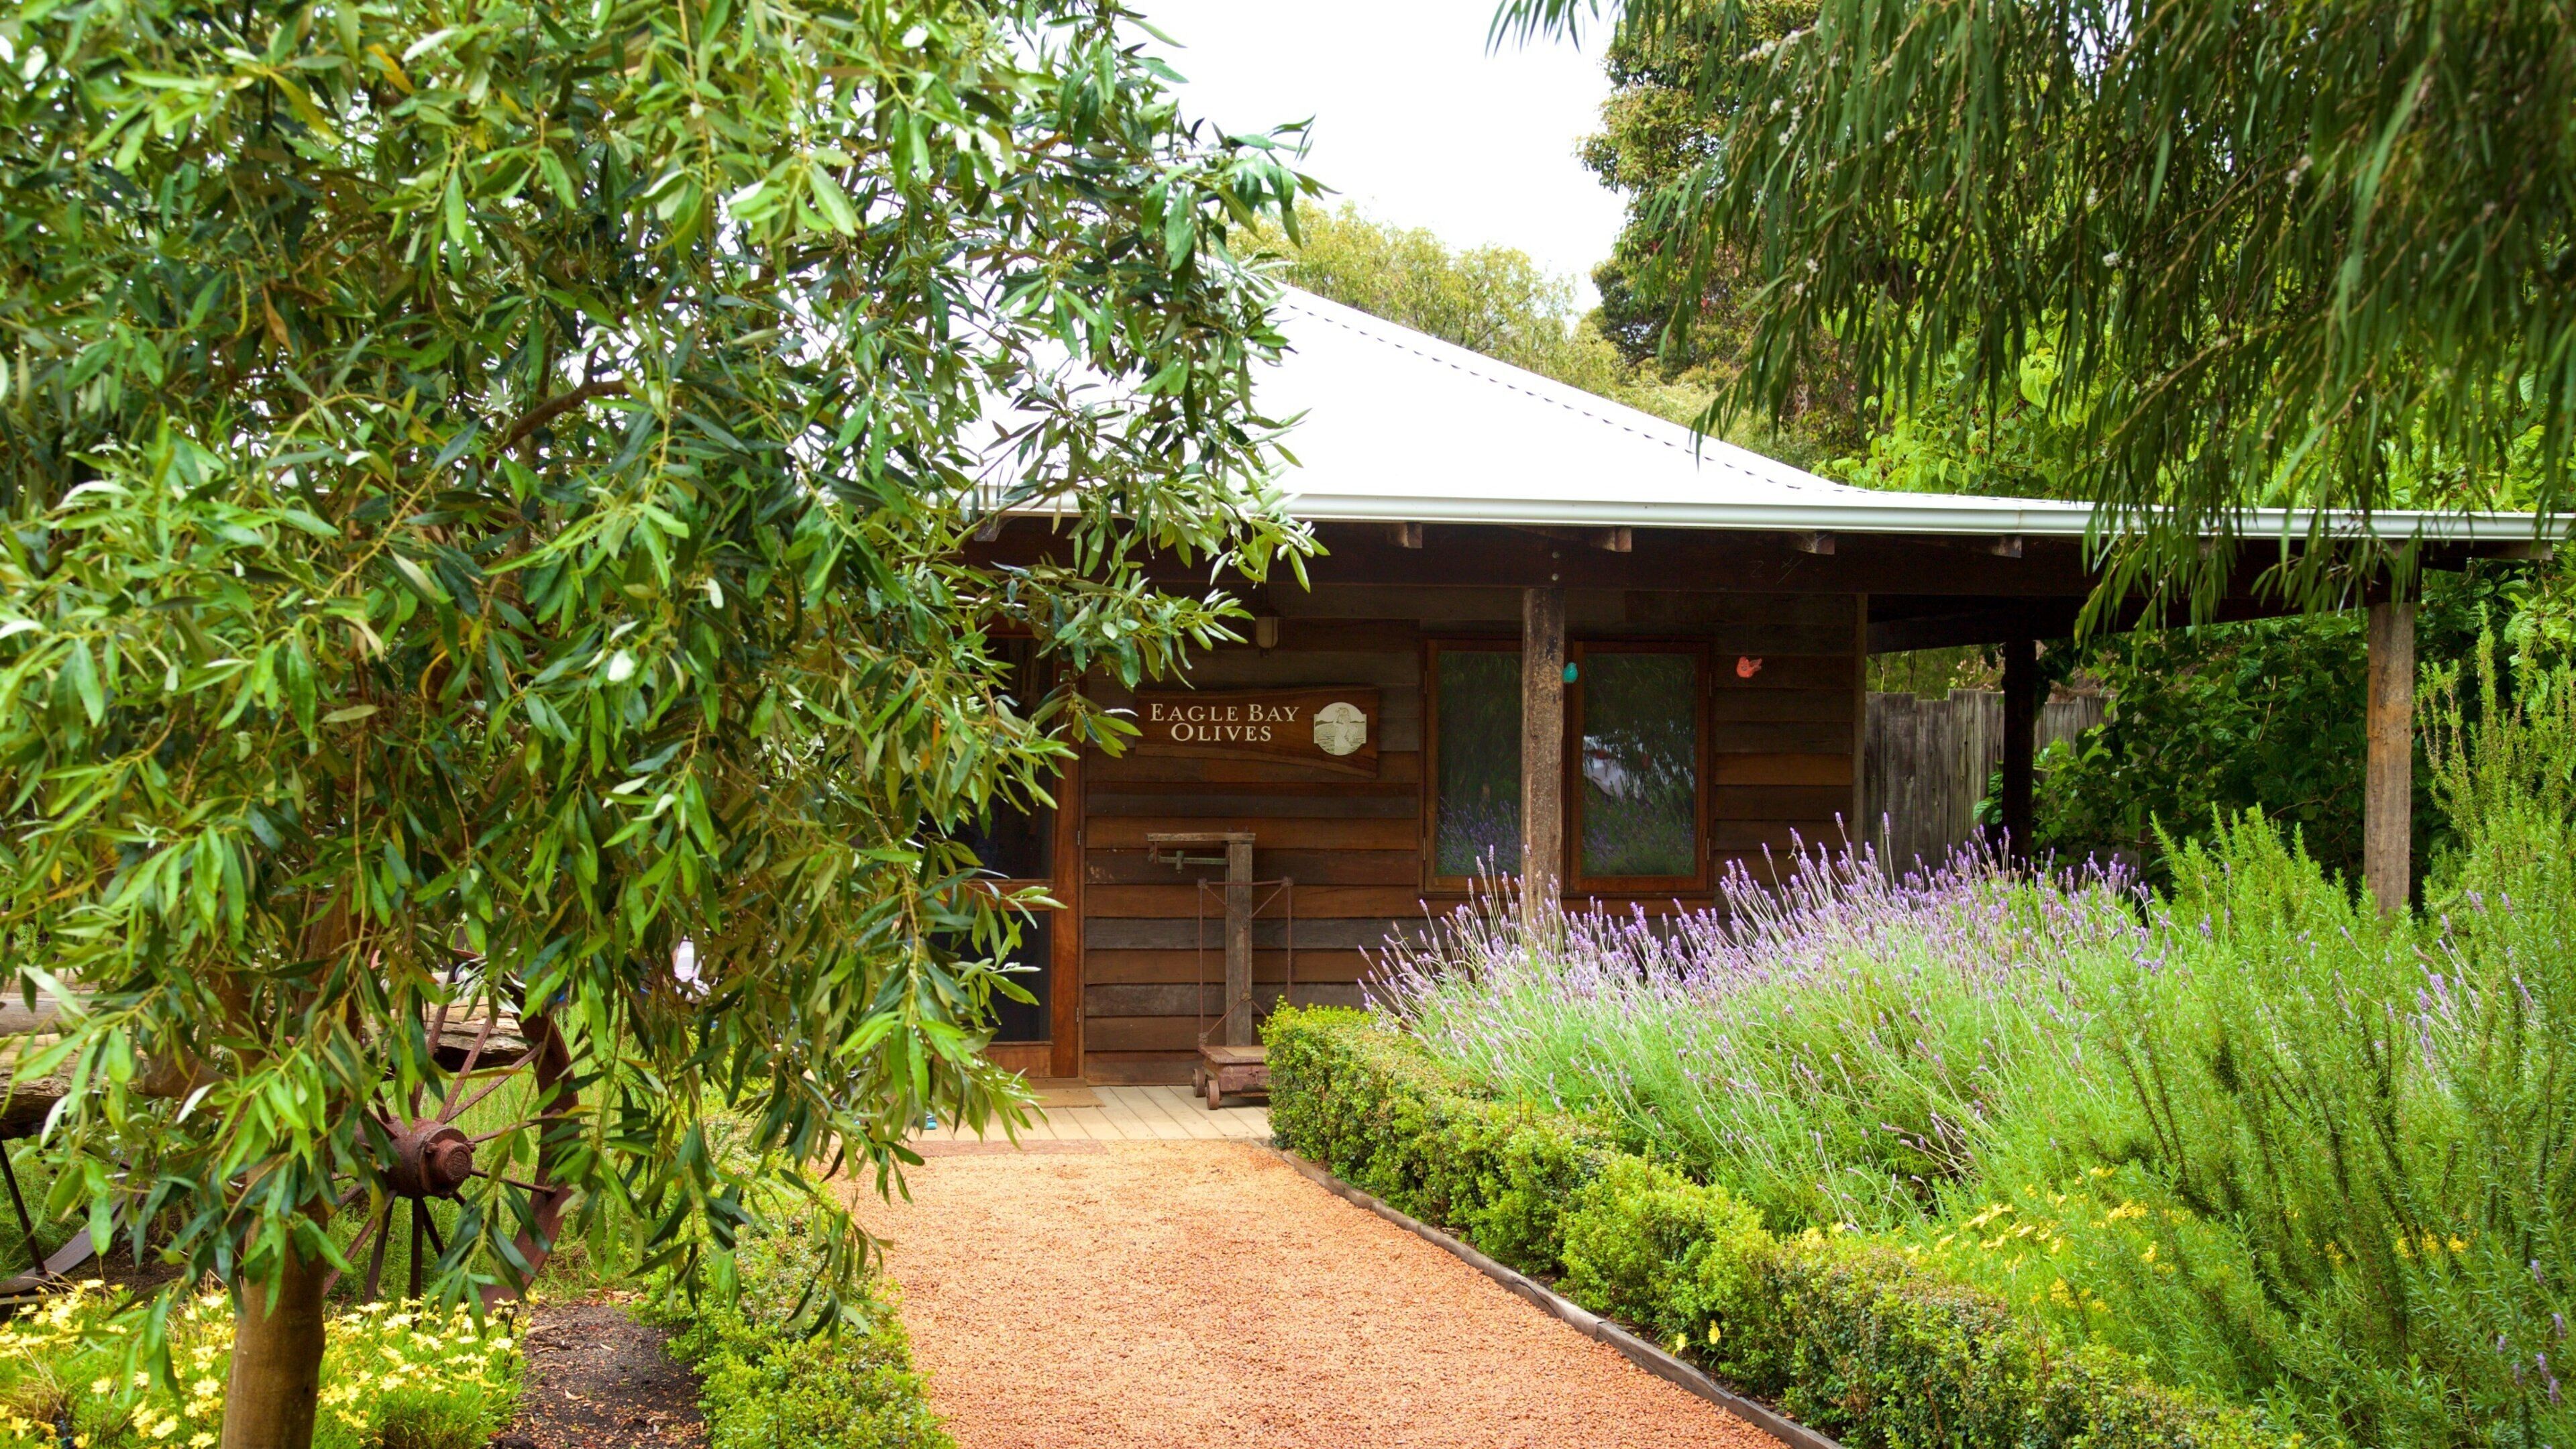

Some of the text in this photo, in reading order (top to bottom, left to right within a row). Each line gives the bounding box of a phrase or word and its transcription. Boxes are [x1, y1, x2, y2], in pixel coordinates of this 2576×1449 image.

[1150, 703, 1299, 722] EAGLE BAY
[1171, 722, 1272, 741] OLIVES
